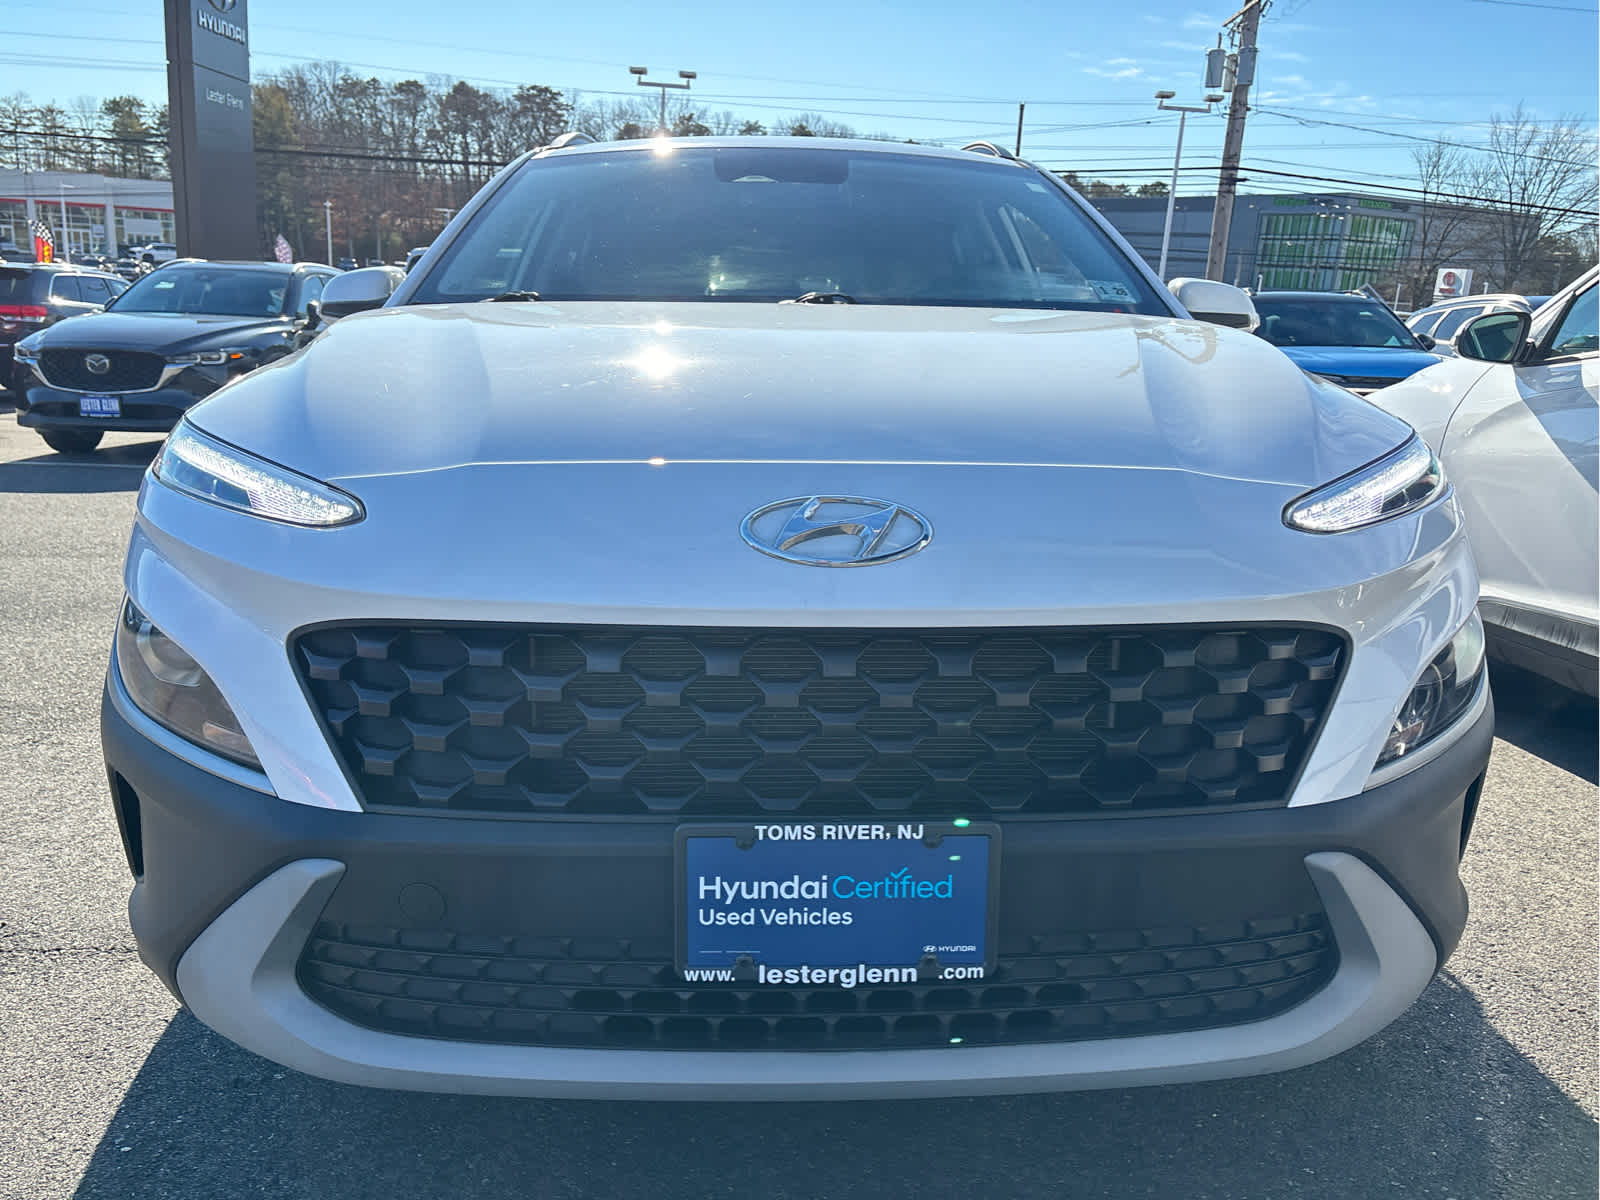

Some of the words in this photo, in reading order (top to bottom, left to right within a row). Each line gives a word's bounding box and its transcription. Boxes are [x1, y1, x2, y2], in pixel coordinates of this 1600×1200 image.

[198, 9, 246, 43] HYUNDAI
[755, 825, 816, 840] TOMS
[823, 824, 890, 840] RIVER,
[897, 824, 924, 840] NJ
[699, 875, 828, 904] Hyundai
[832, 867, 953, 899] Certified
[699, 908, 755, 925] Used
[760, 907, 853, 925] Vehicles
[684, 969, 736, 982] www.
[758, 964, 918, 989] lesterglenn
[938, 966, 984, 980] .com
